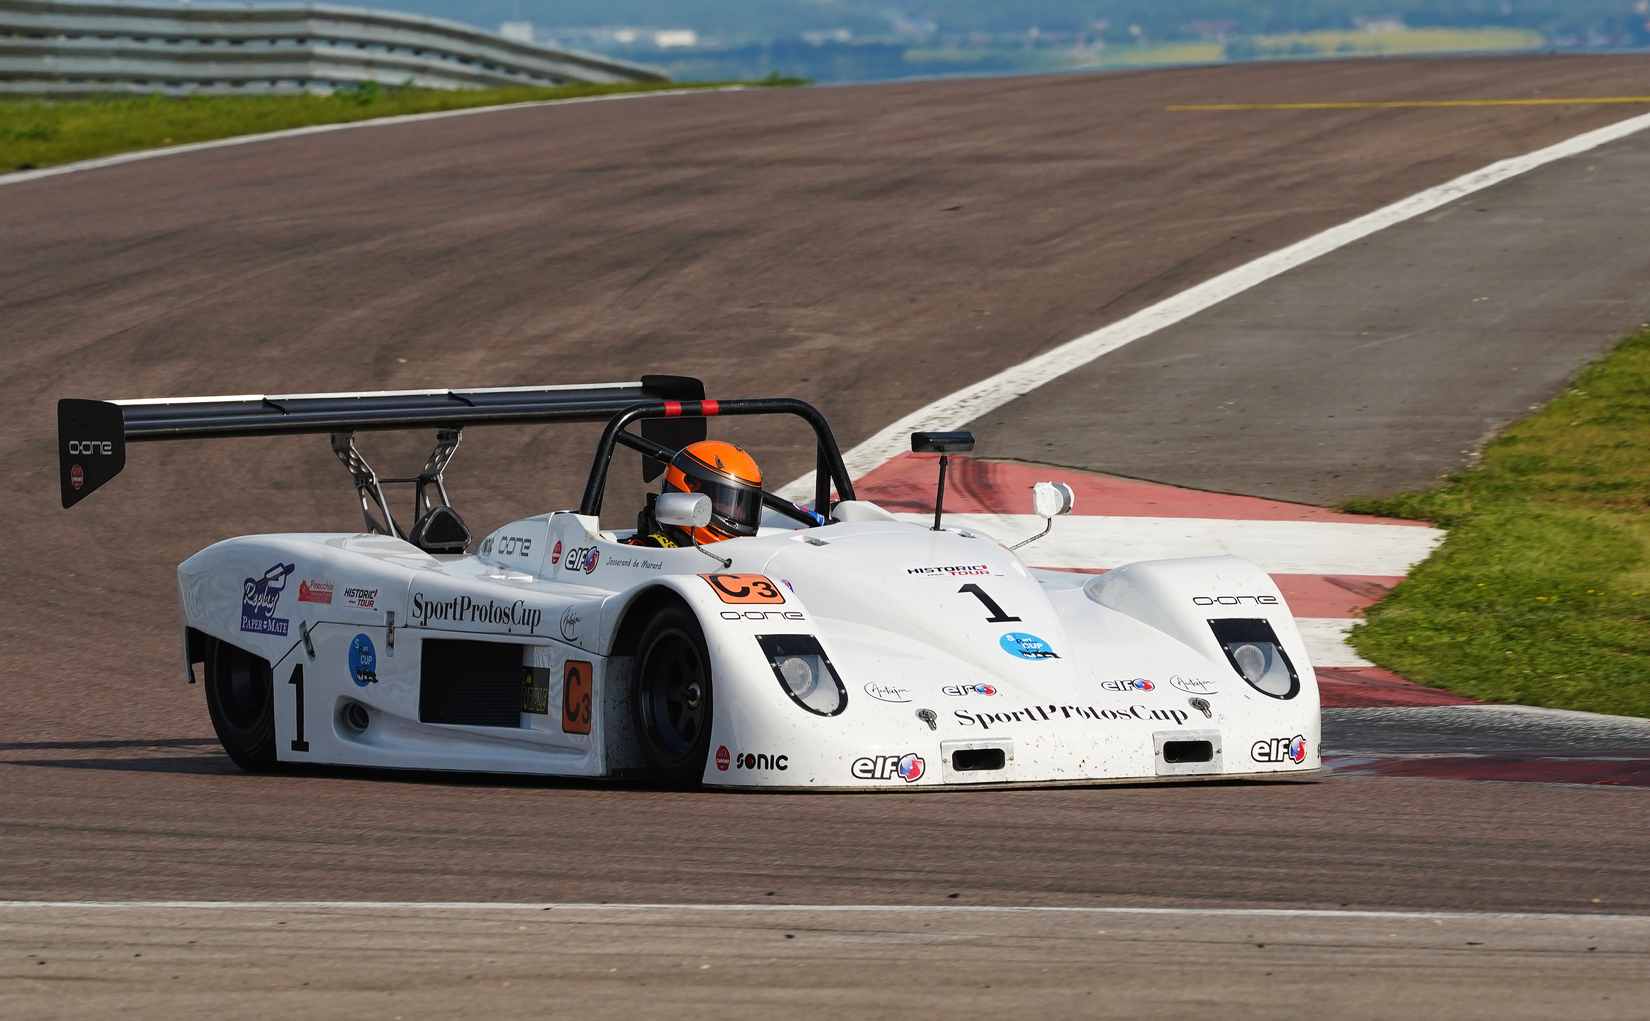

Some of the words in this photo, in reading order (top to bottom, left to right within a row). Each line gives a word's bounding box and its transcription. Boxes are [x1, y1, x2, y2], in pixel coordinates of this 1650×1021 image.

[565, 547, 588, 571] elf
[357, 599, 375, 608] TOUR
[412, 592, 541, 633] SportProtosCup
[958, 583, 1023, 623] 1
[360, 655, 373, 665] CUP
[1101, 679, 1135, 691] elf
[288, 664, 310, 752] 1
[954, 701, 1189, 729] SportProtosCup
[1251, 738, 1291, 763] elf
[851, 755, 900, 779] elf
